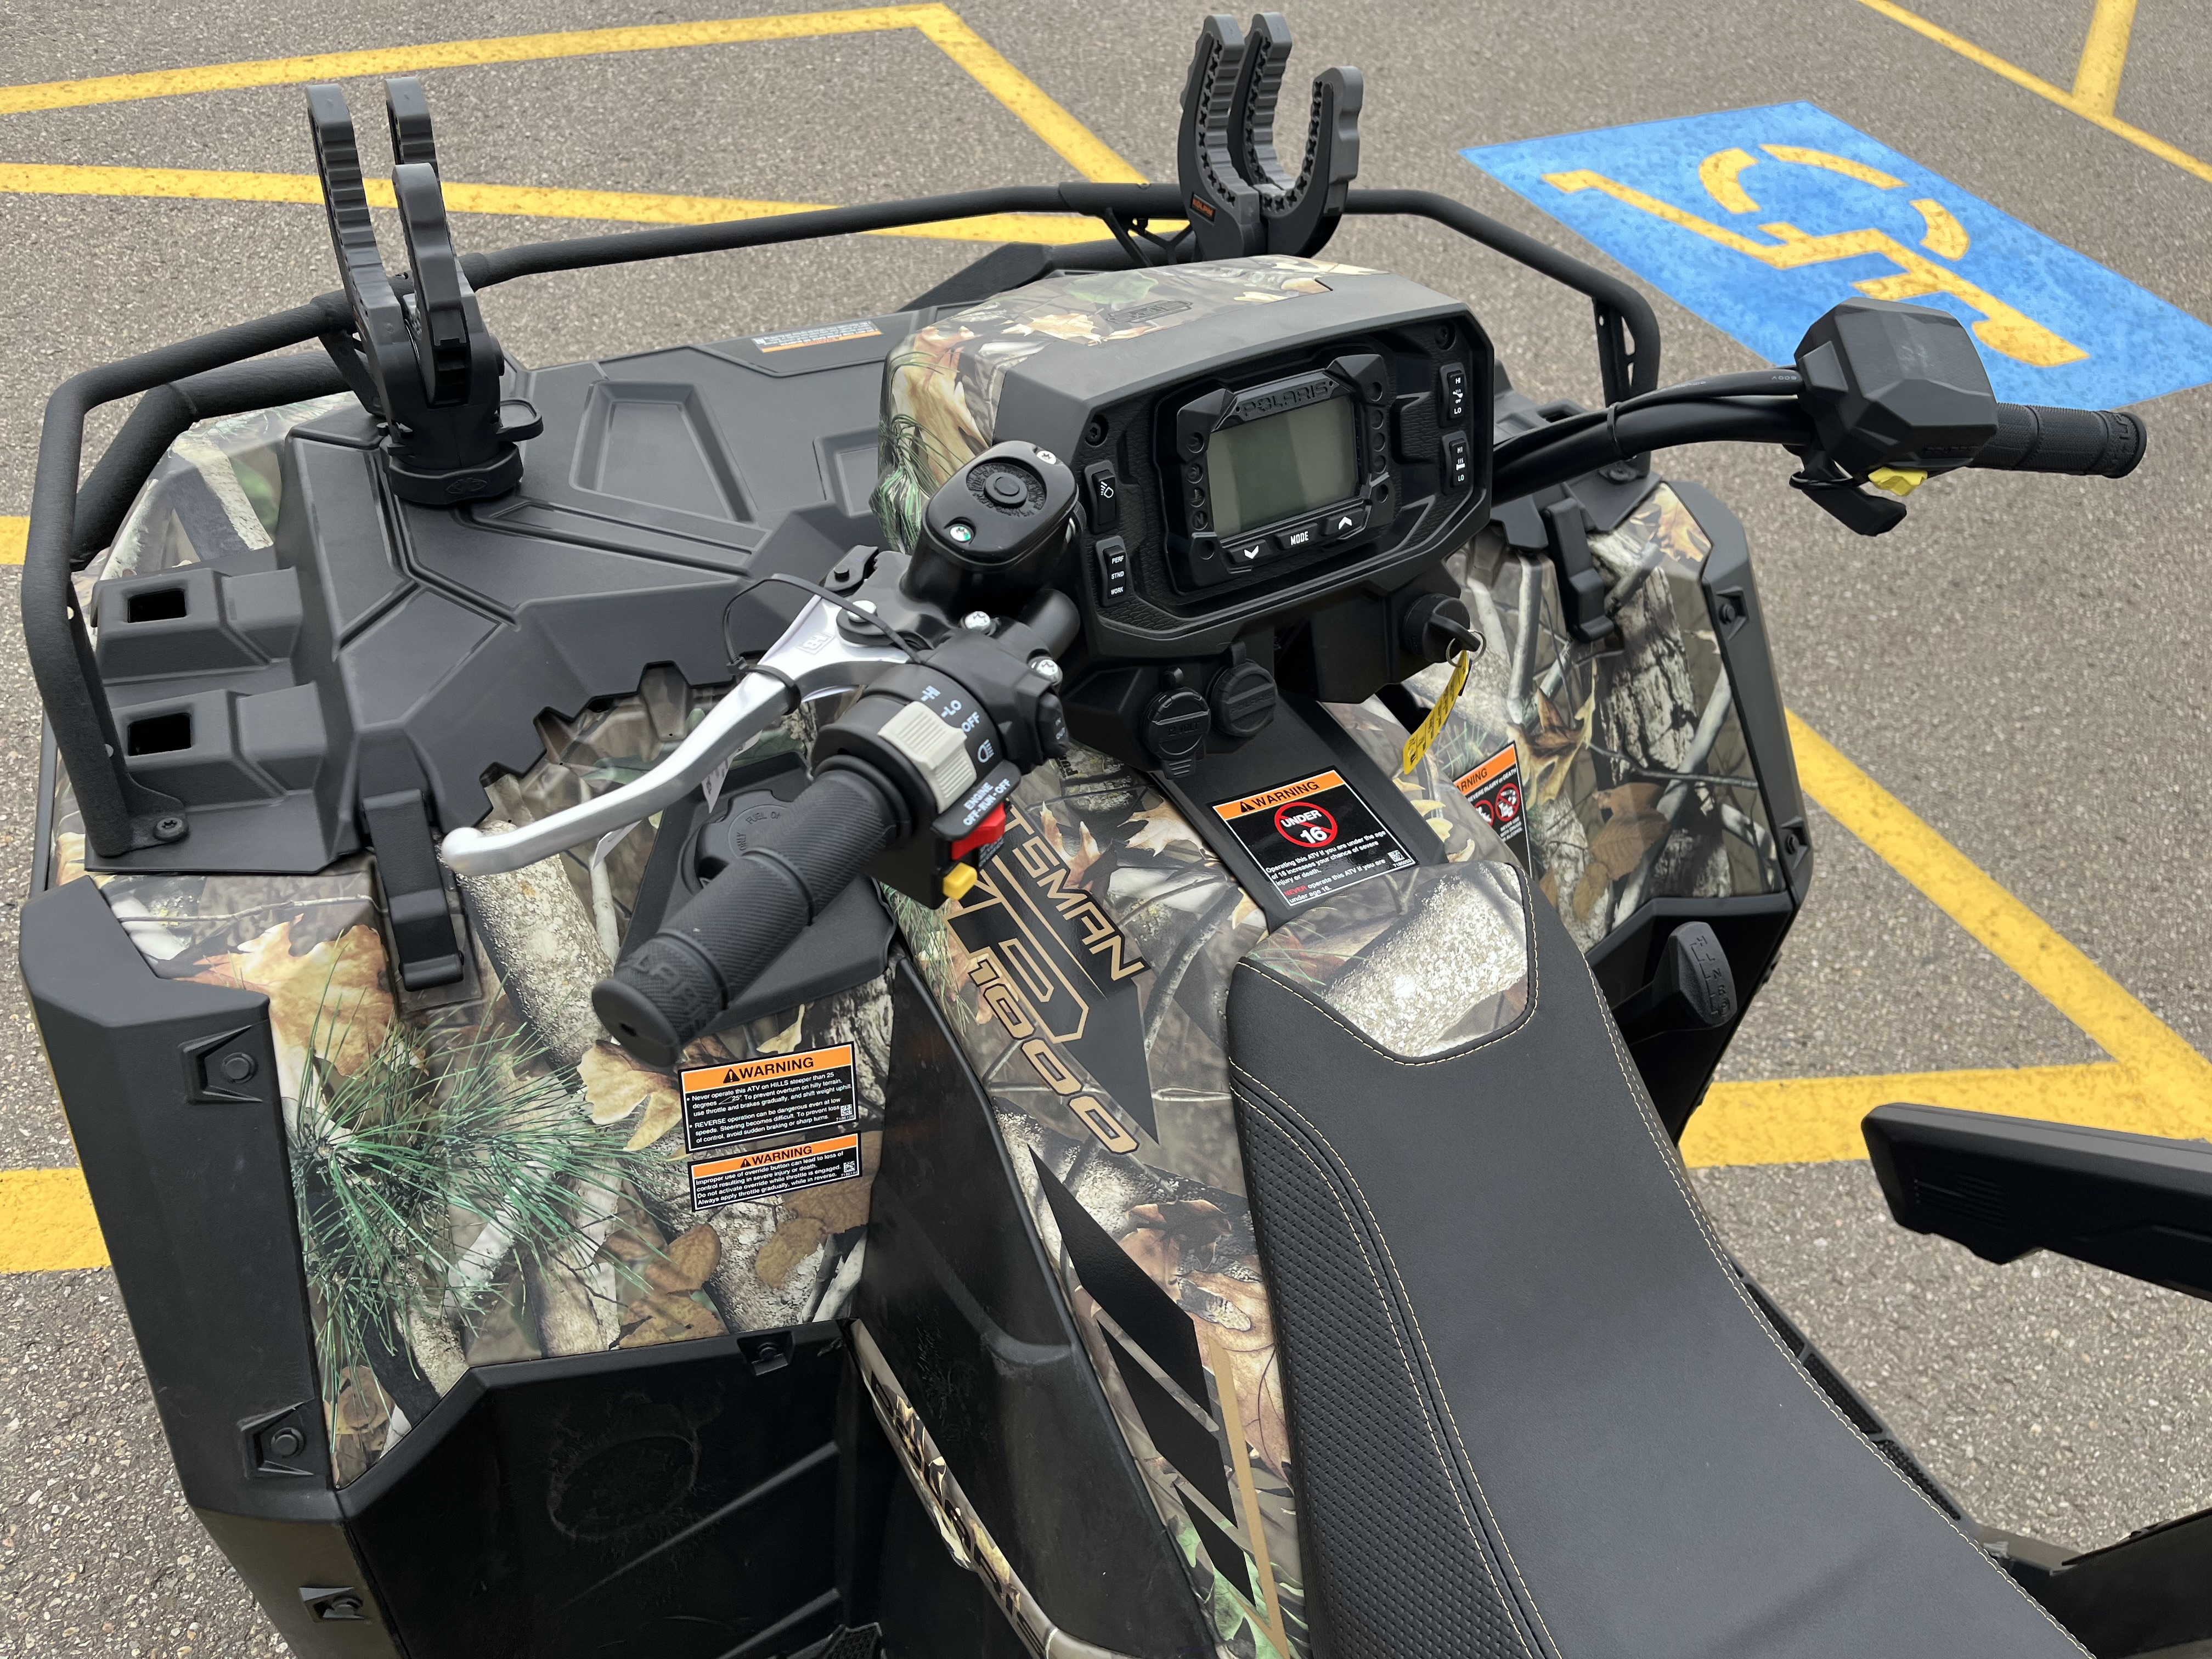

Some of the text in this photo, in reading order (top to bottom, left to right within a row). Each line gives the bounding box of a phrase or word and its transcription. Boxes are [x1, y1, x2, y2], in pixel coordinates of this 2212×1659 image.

[1242, 381, 1330, 416] POLARIS
[1194, 513, 1204, 527] N
[1290, 531, 1310, 546] MODE
[1111, 555, 1124, 564] PERF
[1111, 570, 1124, 579] STND
[1110, 586, 1124, 595] WORK
[961, 711, 980, 733] OFF
[1483, 779, 1498, 792] INJURY
[1502, 768, 1516, 780] DEATH
[963, 782, 994, 811] ENGINE
[1251, 781, 1319, 806] WARNING
[745, 812, 768, 824] FUEL
[1280, 810, 1321, 827] UNDER
[1300, 826, 1329, 845] 16
[1265, 860, 1296, 873] Operating
[1307, 851, 1319, 860] ATV
[1324, 847, 1337, 855] you
[1346, 837, 1364, 847] under
[1286, 862, 1316, 874] increases
[1315, 857, 1329, 866] your
[1330, 850, 1352, 860] chance
[1358, 840, 1379, 850] severe
[1275, 877, 1294, 886] injury
[1301, 868, 1322, 878] death.
[1284, 885, 1307, 896] NEVER
[1307, 877, 1332, 889] operate
[1344, 867, 1357, 876] ATV
[1362, 862, 1375, 871] you
[1008, 805, 1146, 981] TSMAN
[1289, 893, 1308, 903] under
[1308, 889, 1323, 898] age
[1712, 967, 1723, 980] N
[968, 956, 1141, 1154] 1000
[739, 1057, 813, 1078] WARNING
[692, 1101, 717, 1109] degrees
[753, 1090, 775, 1099] prevent
[776, 1086, 800, 1094] overturn
[711, 1090, 734, 1098] operate
[770, 1080, 788, 1088] HILLS
[789, 1076, 811, 1085] steeper
[761, 1096, 789, 1106] gradually,
[695, 1118, 726, 1128] REVERSE
[727, 1114, 755, 1122] operation
[777, 1104, 807, 1113] dangerous
[695, 1127, 718, 1136] speeds.
[720, 1123, 744, 1131] Steering
[746, 1118, 772, 1127] becomes
[805, 1107, 827, 1116] prevent
[726, 1130, 742, 1138] avoid
[752, 1146, 811, 1165] WARNING
[696, 1176, 723, 1185] Improper
[744, 1167, 769, 1176] override
[696, 1183, 718, 1192] control
[719, 1178, 745, 1187] resulting
[718, 1186, 742, 1194] activate
[743, 1180, 768, 1189] override
[786, 1172, 807, 1180] throttle
[814, 1164, 841, 1174] engaged.
[738, 1188, 760, 1197] throttle
[761, 1182, 789, 1193] gradually,
[814, 1172, 837, 1181] reverse.
[871, 1370, 1046, 1655] POLARIS
